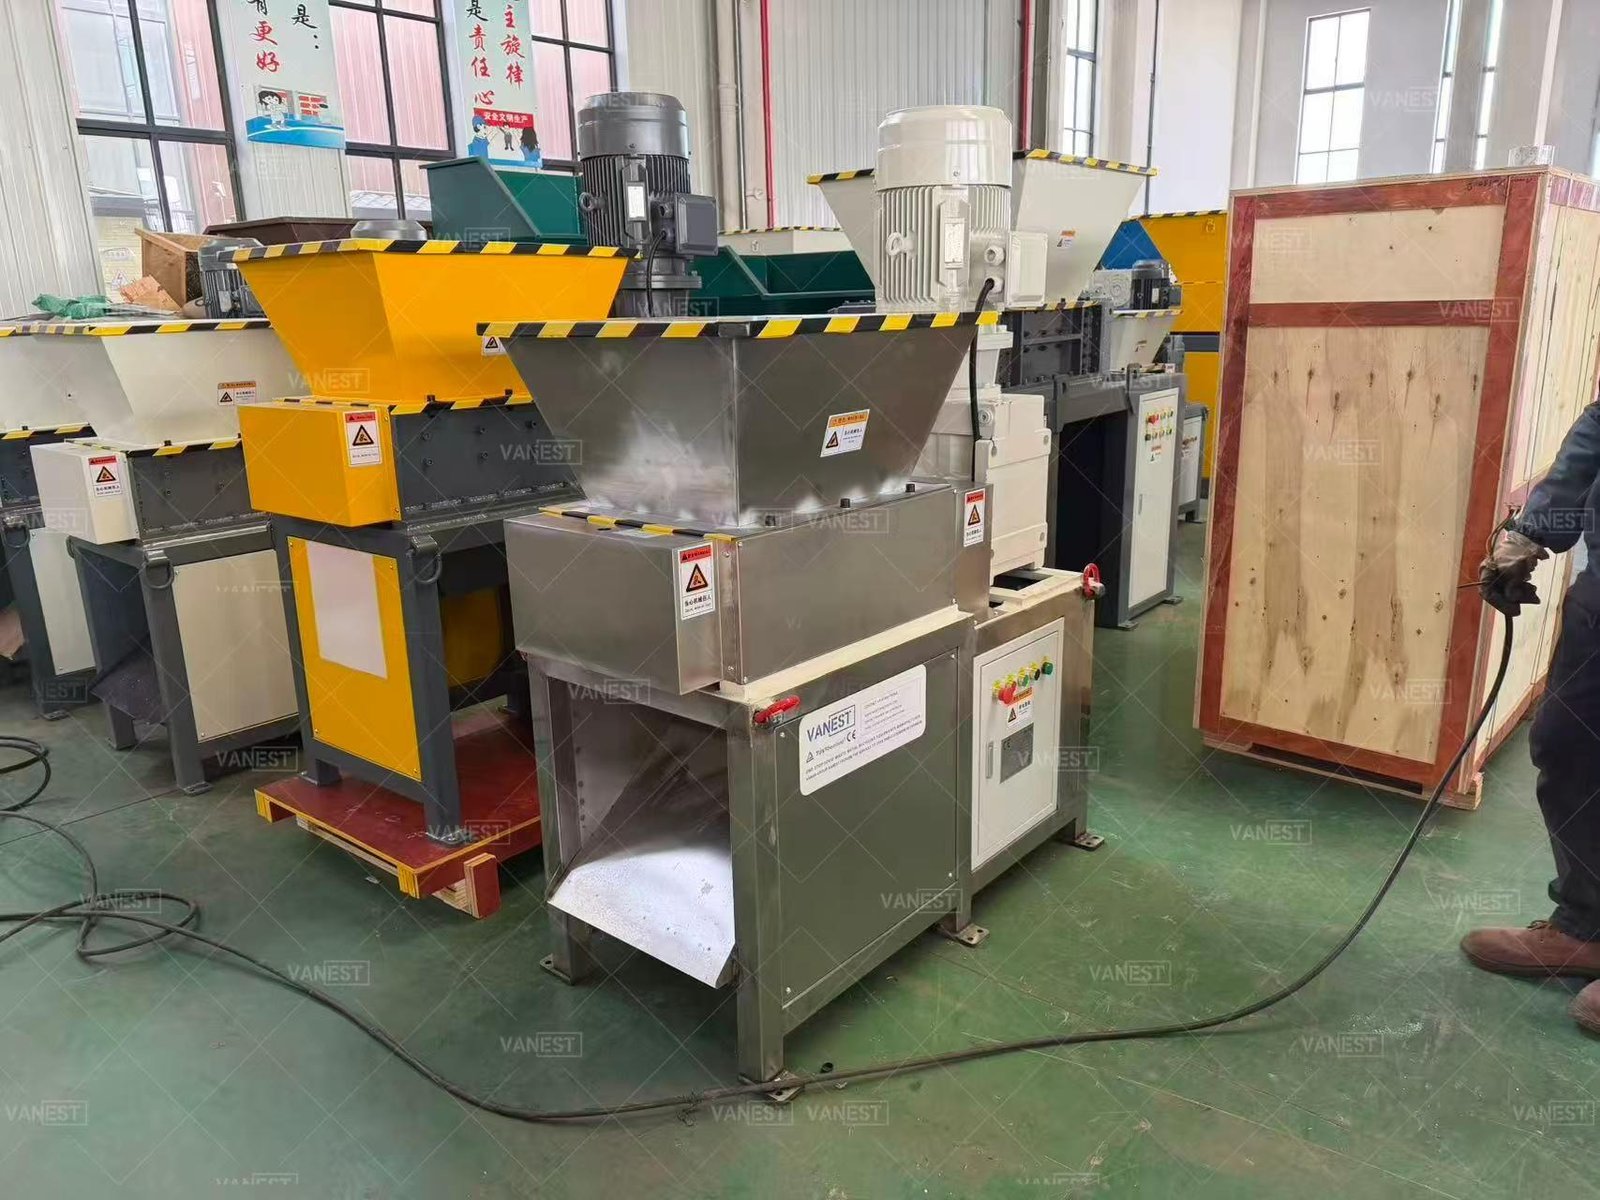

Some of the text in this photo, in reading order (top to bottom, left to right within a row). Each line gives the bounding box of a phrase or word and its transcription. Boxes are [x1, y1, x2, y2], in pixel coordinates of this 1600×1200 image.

[466, 0, 495, 105] 是责任心
[500, 0, 525, 91] 主旋律
[807, 709, 854, 742] VANEST
